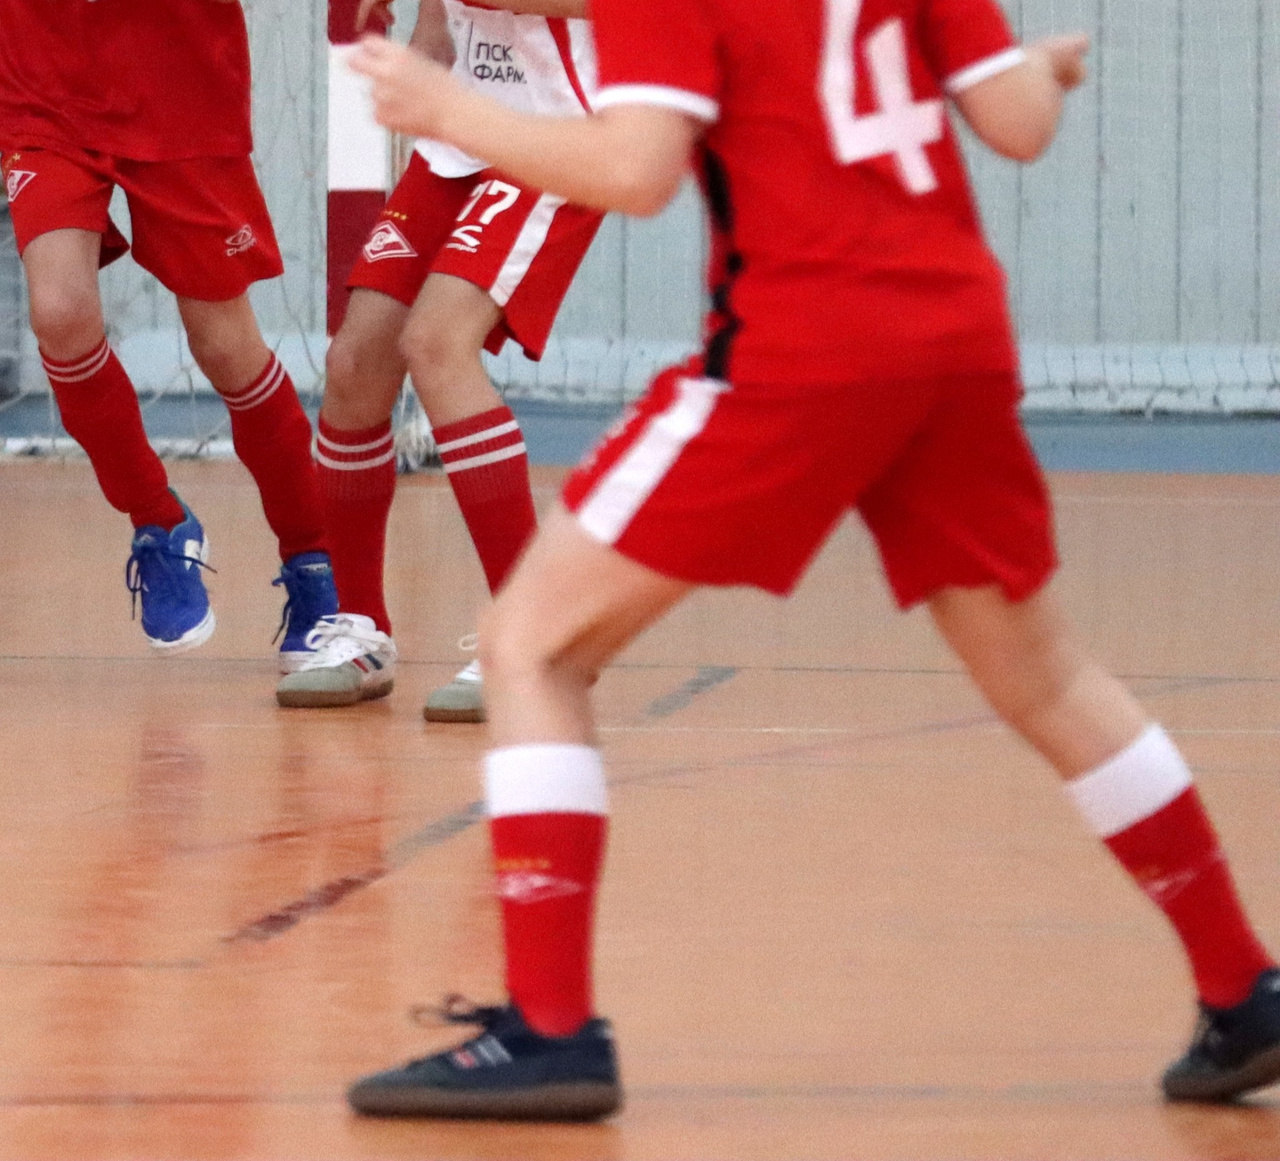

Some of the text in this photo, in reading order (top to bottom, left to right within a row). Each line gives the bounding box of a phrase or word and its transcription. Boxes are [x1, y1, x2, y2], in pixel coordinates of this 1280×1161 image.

[476, 42, 514, 62] ПСК
[473, 64, 527, 84] ФАРМ
[456, 179, 521, 225] 17
